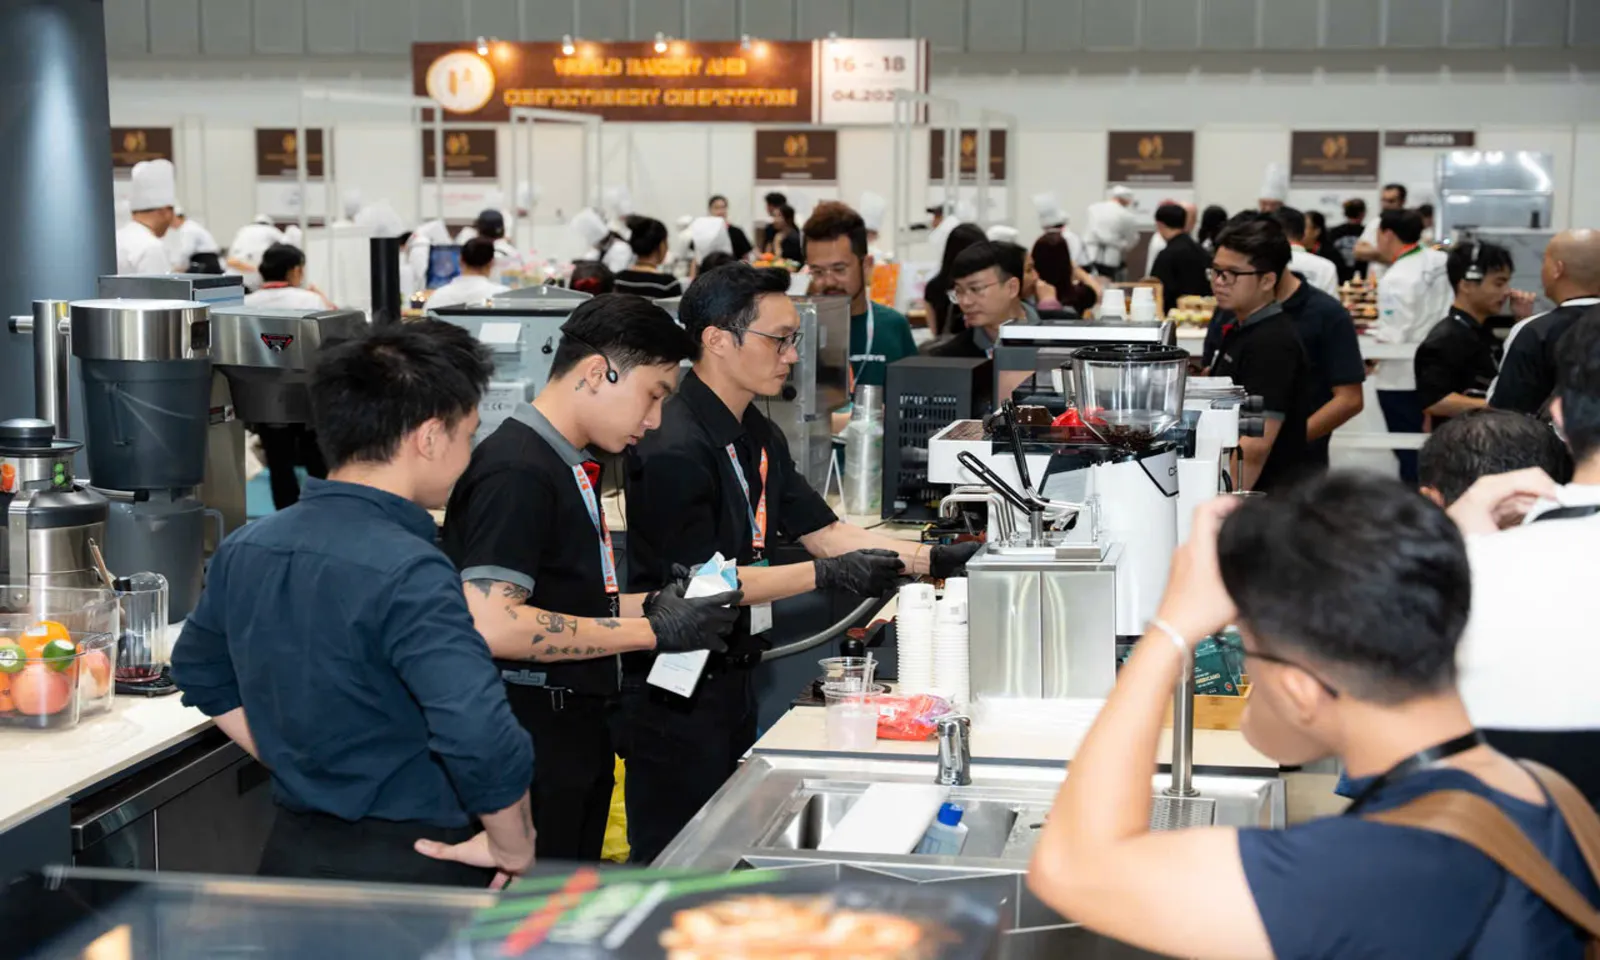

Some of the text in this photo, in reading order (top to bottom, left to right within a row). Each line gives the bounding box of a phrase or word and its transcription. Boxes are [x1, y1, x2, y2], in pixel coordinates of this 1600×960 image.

[833, 57, 855, 72] 16
[883, 56, 906, 72] 18
[832, 89, 896, 102] 04.202
